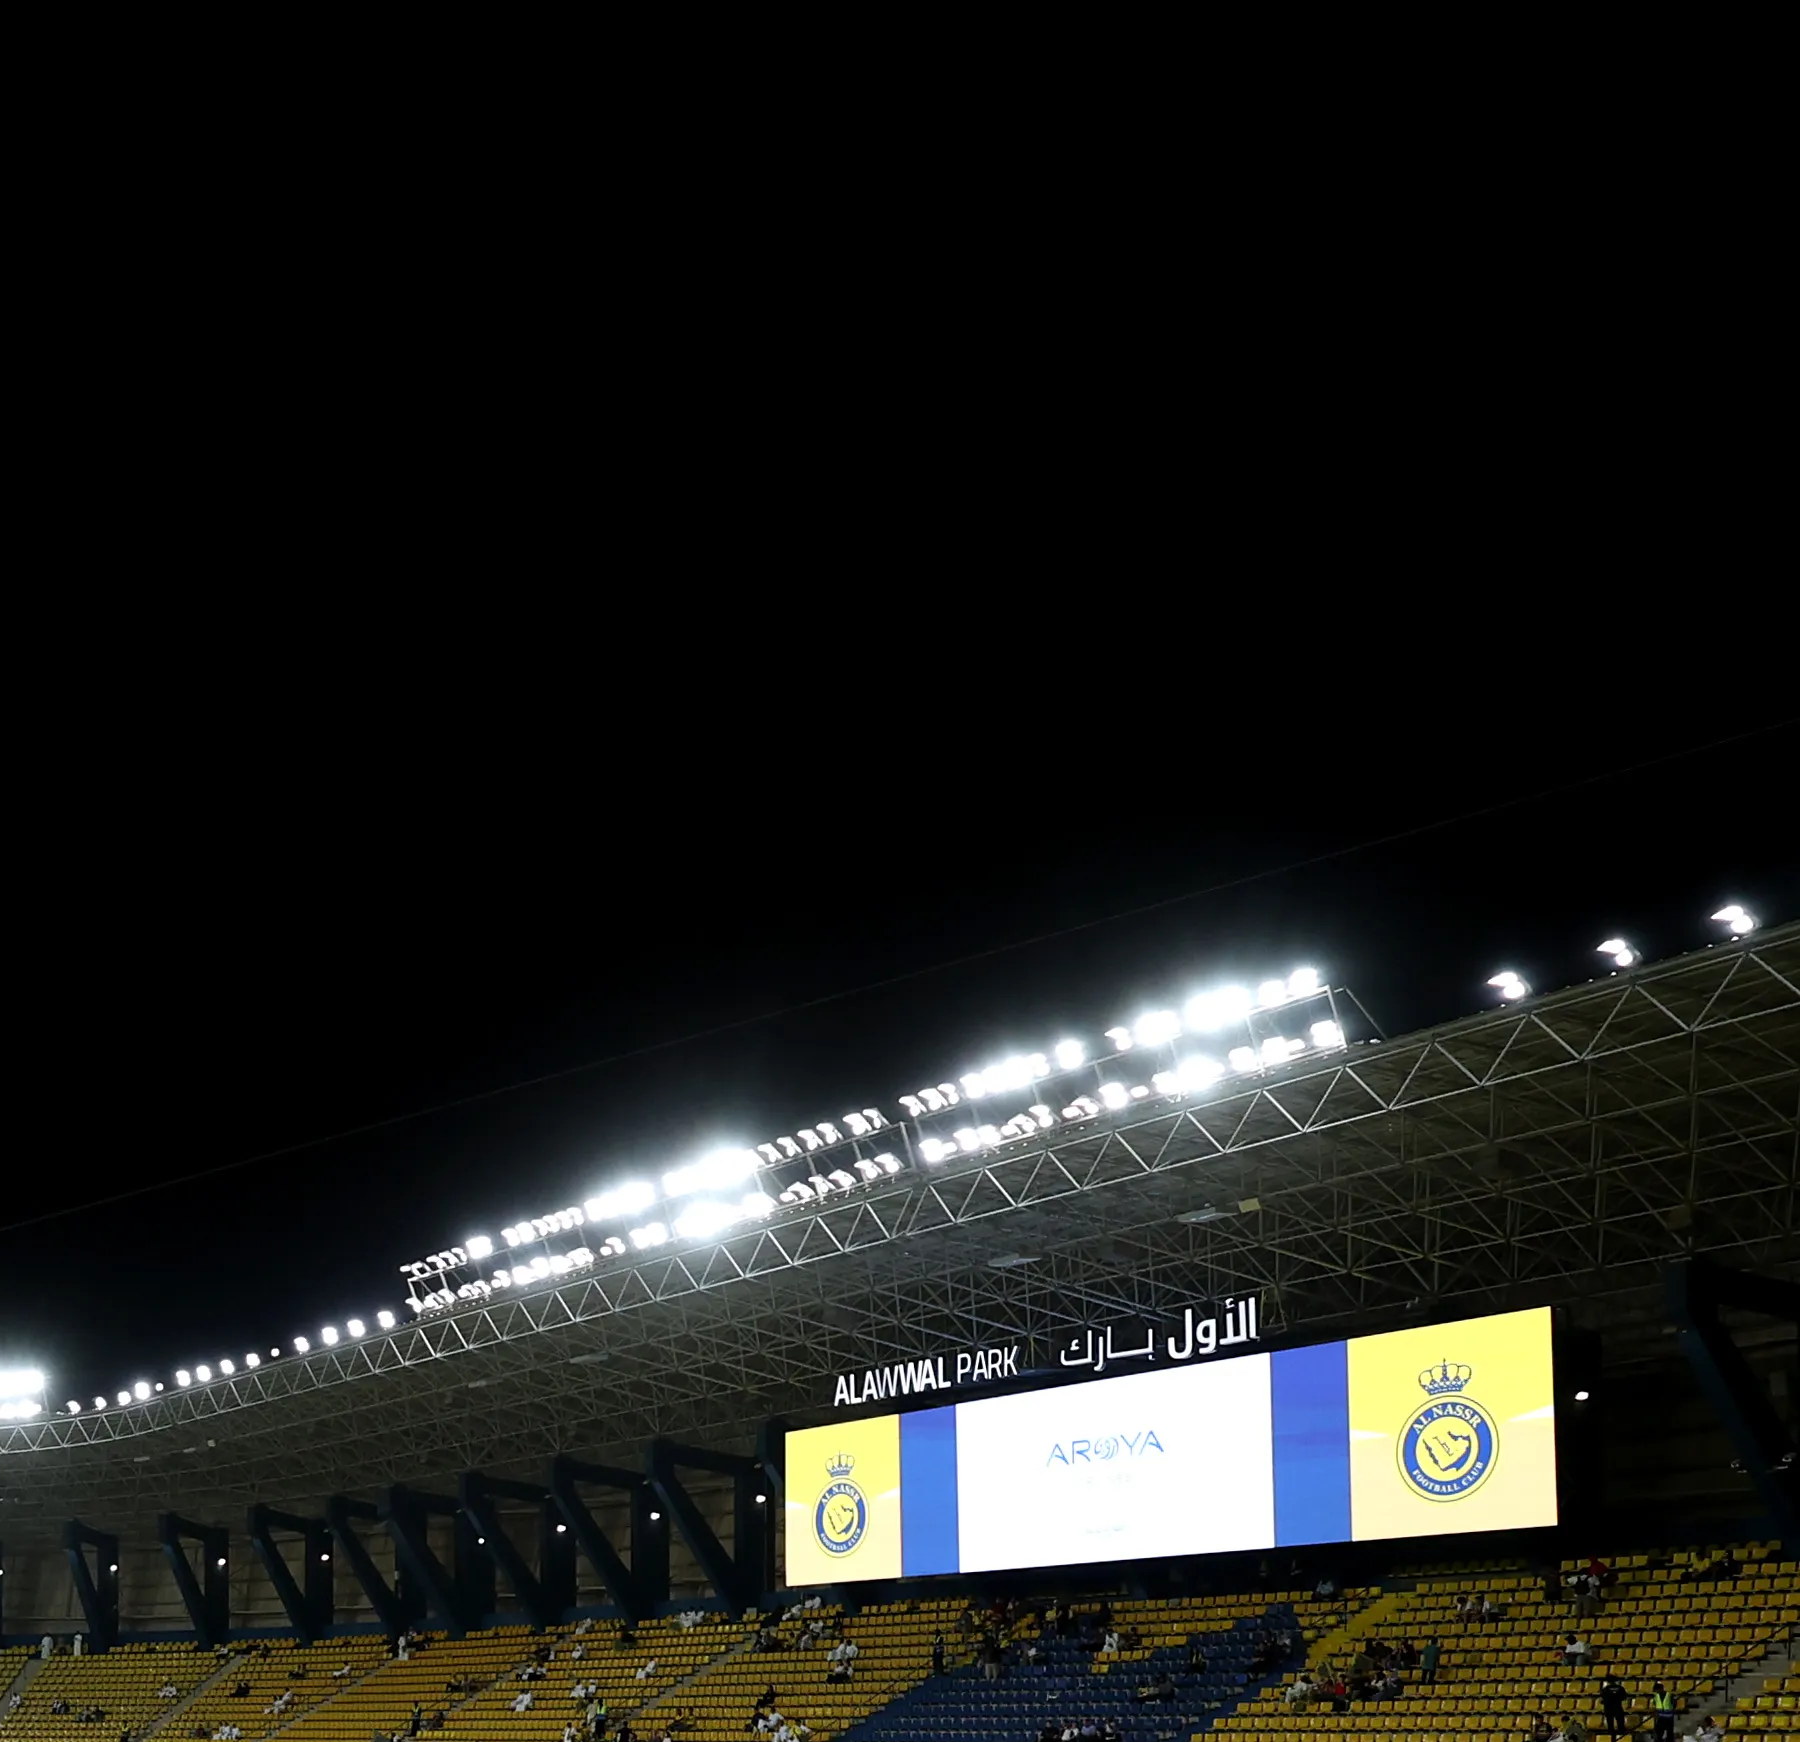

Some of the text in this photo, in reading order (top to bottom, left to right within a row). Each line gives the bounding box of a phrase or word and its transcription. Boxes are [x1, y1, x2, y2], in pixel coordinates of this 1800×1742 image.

[1167, 1297, 1258, 1360] الأول
[834, 1346, 1020, 1407] ALAWWAL PARK
[1412, 1403, 1482, 1435] AL NASSR
[1412, 1461, 1484, 1493] FOOTBALL CLUB
